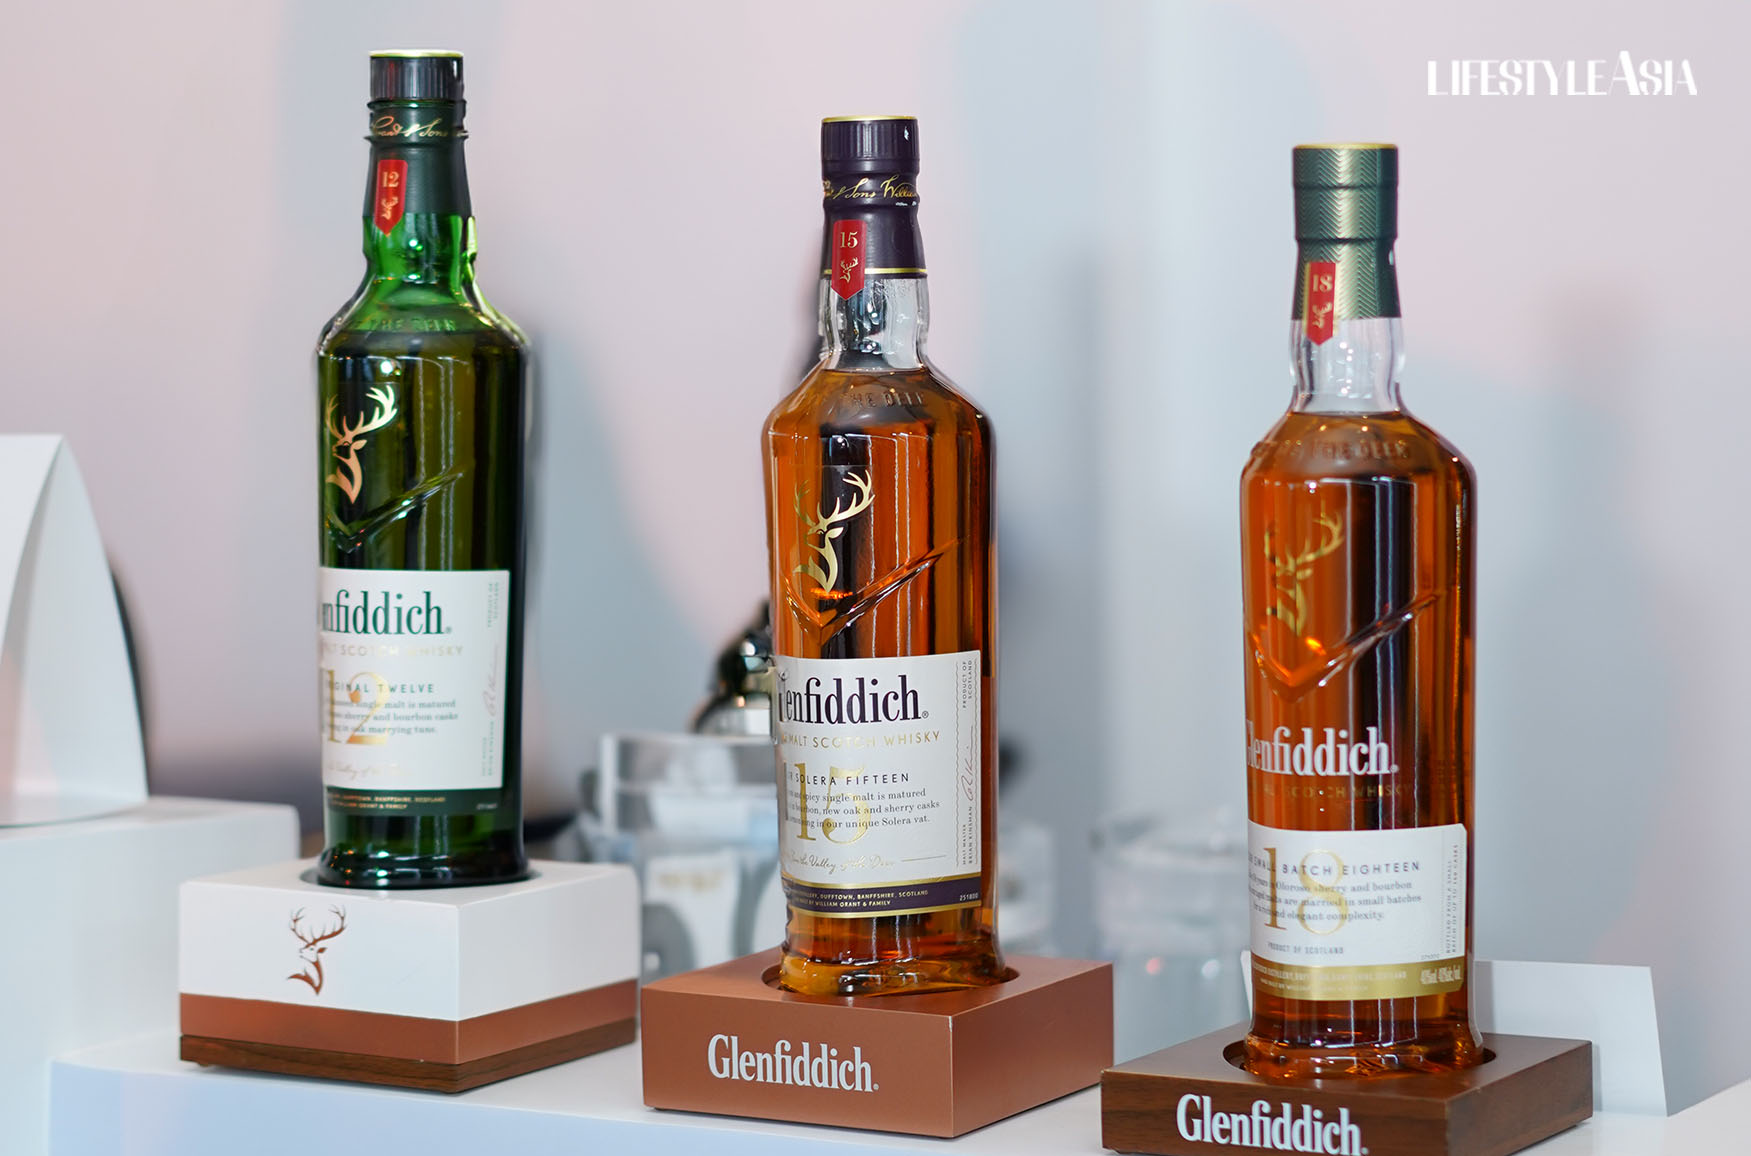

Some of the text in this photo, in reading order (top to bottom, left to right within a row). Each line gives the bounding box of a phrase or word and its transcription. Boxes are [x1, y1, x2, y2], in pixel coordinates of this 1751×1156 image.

[382, 171, 399, 188] 12
[840, 231, 858, 248] 15
[1312, 274, 1333, 293] 18
[378, 684, 434, 693] TWELVE
[326, 669, 391, 745] 12
[813, 736, 876, 749] SCOTCH
[883, 730, 940, 747] WHISKY
[795, 773, 837, 786] SOLERA
[846, 773, 910, 786] FIFTEEN
[794, 762, 871, 844] 15
[822, 793, 850, 804] single
[852, 791, 875, 801] malt
[877, 792, 886, 800] is
[888, 788, 926, 800] matured
[843, 805, 861, 815] oak
[864, 804, 882, 815] and
[884, 803, 914, 815] sherry
[917, 800, 940, 810] casks
[845, 819, 879, 830] unique
[882, 816, 911, 826] Solera
[914, 815, 930, 823] vat.
[808, 854, 837, 875] Valley
[1282, 863, 1332, 875] BATCH
[1342, 861, 1421, 876] EIGHTEEN
[899, 890, 929, 898] SCOTLAND
[1263, 847, 1349, 936] 18
[1350, 882, 1369, 892] and
[1372, 880, 1412, 892] bourbon
[1358, 894, 1384, 905] small
[707, 1033, 874, 1092] Glenfiddich
[1176, 1093, 1362, 1156] Glenfiddich
